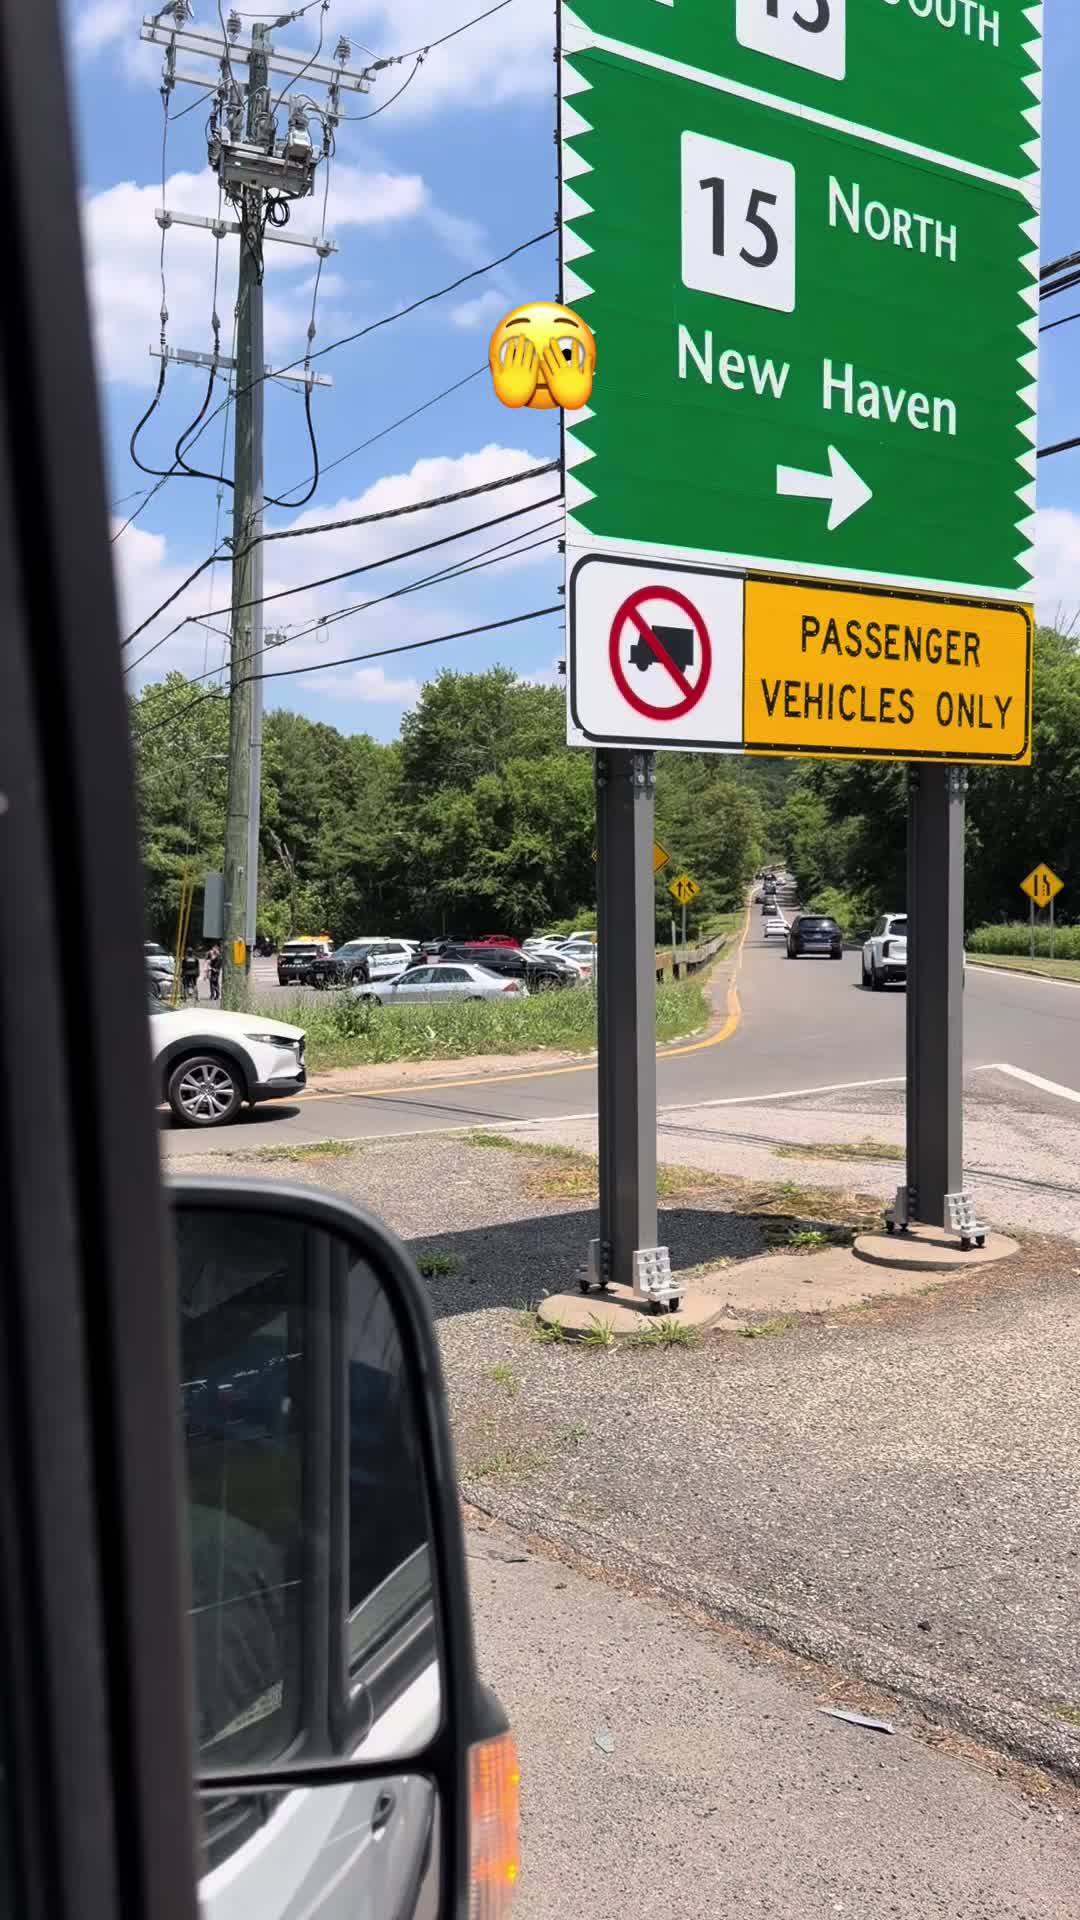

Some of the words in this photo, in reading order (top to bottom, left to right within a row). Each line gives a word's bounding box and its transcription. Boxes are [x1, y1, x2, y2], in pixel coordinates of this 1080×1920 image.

[884, 0, 1000, 48] UTH
[699, 177, 778, 268] 15
[828, 175, 957, 262] NORTH
[678, 324, 790, 399] New
[822, 358, 957, 436] Haven
[801, 614, 981, 667] PASSENGER
[761, 679, 914, 724] VEHICLES
[936, 691, 1012, 729] ONLY
